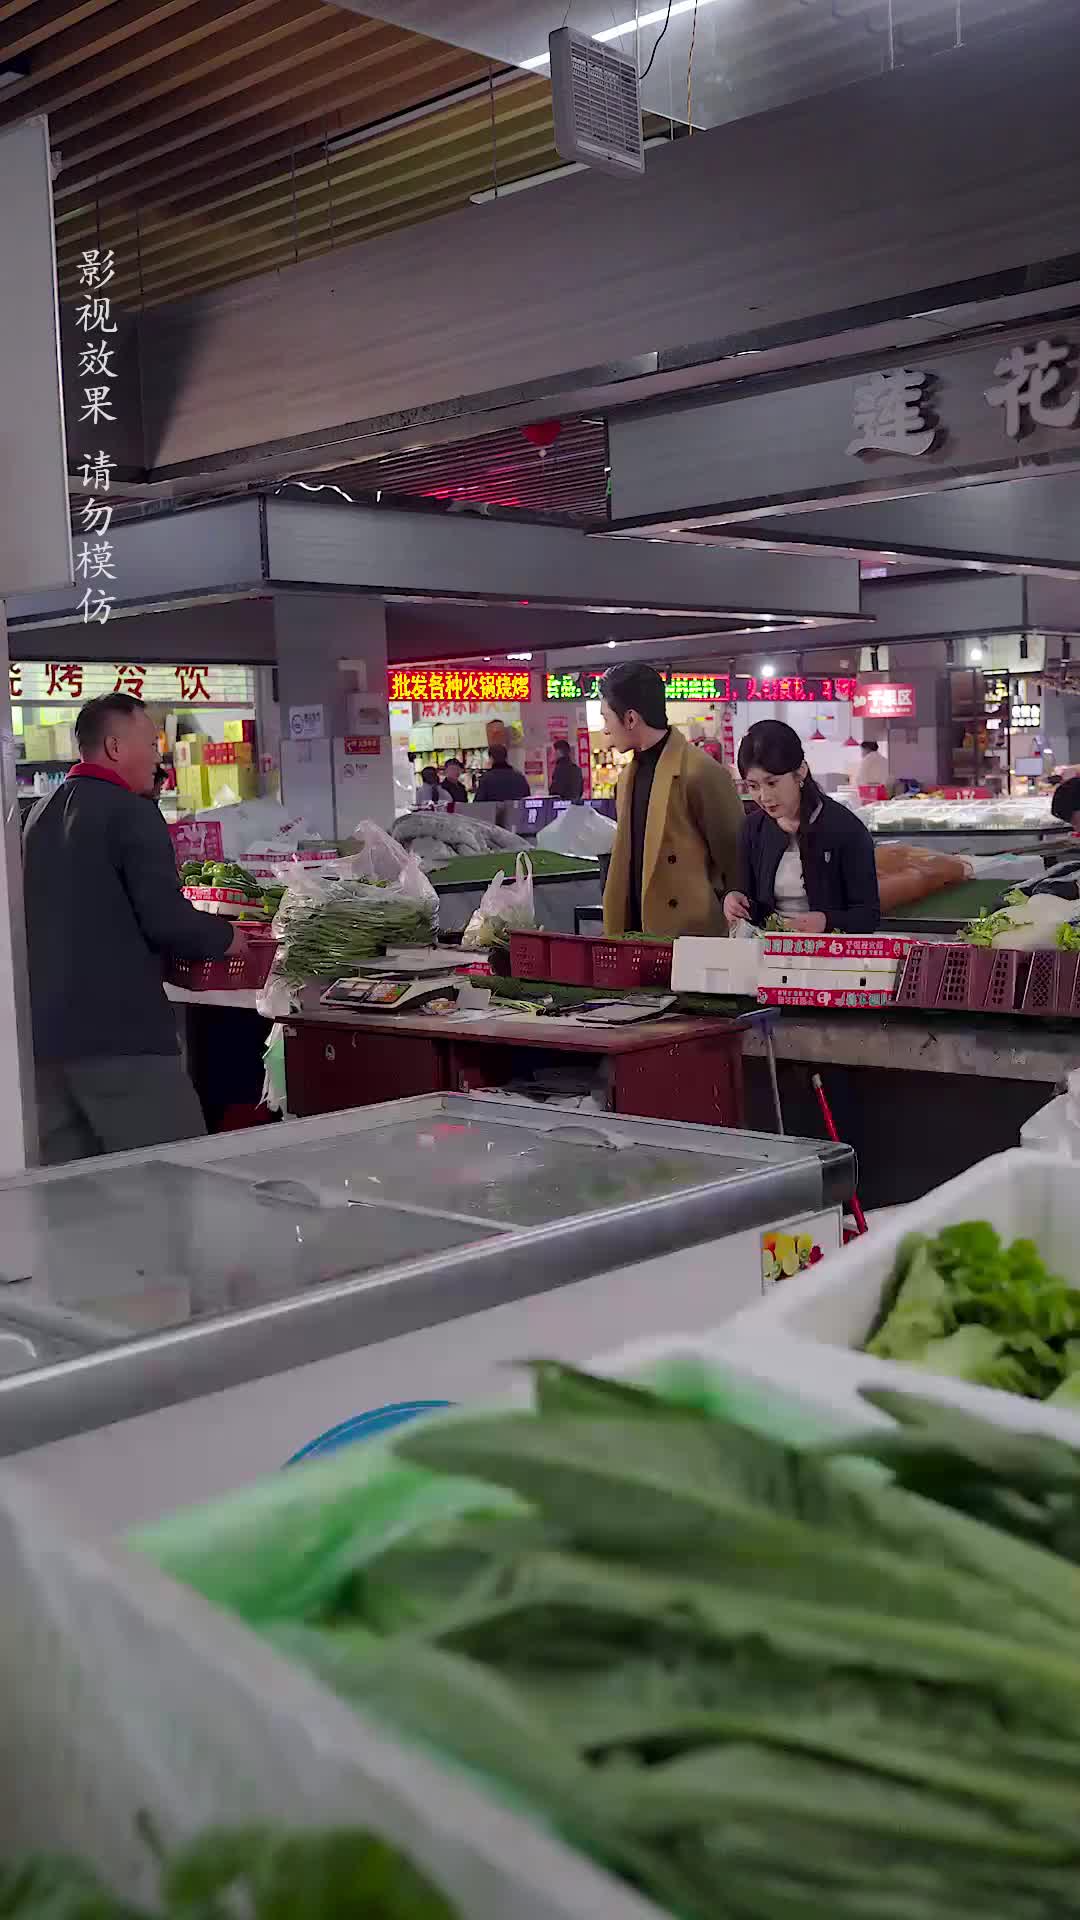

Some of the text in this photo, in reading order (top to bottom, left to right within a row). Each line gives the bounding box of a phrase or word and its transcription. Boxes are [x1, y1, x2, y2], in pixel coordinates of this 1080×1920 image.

[845, 340, 1080, 456] 莲花
[392, 674, 529, 699] 批发各种火锅烧烤
